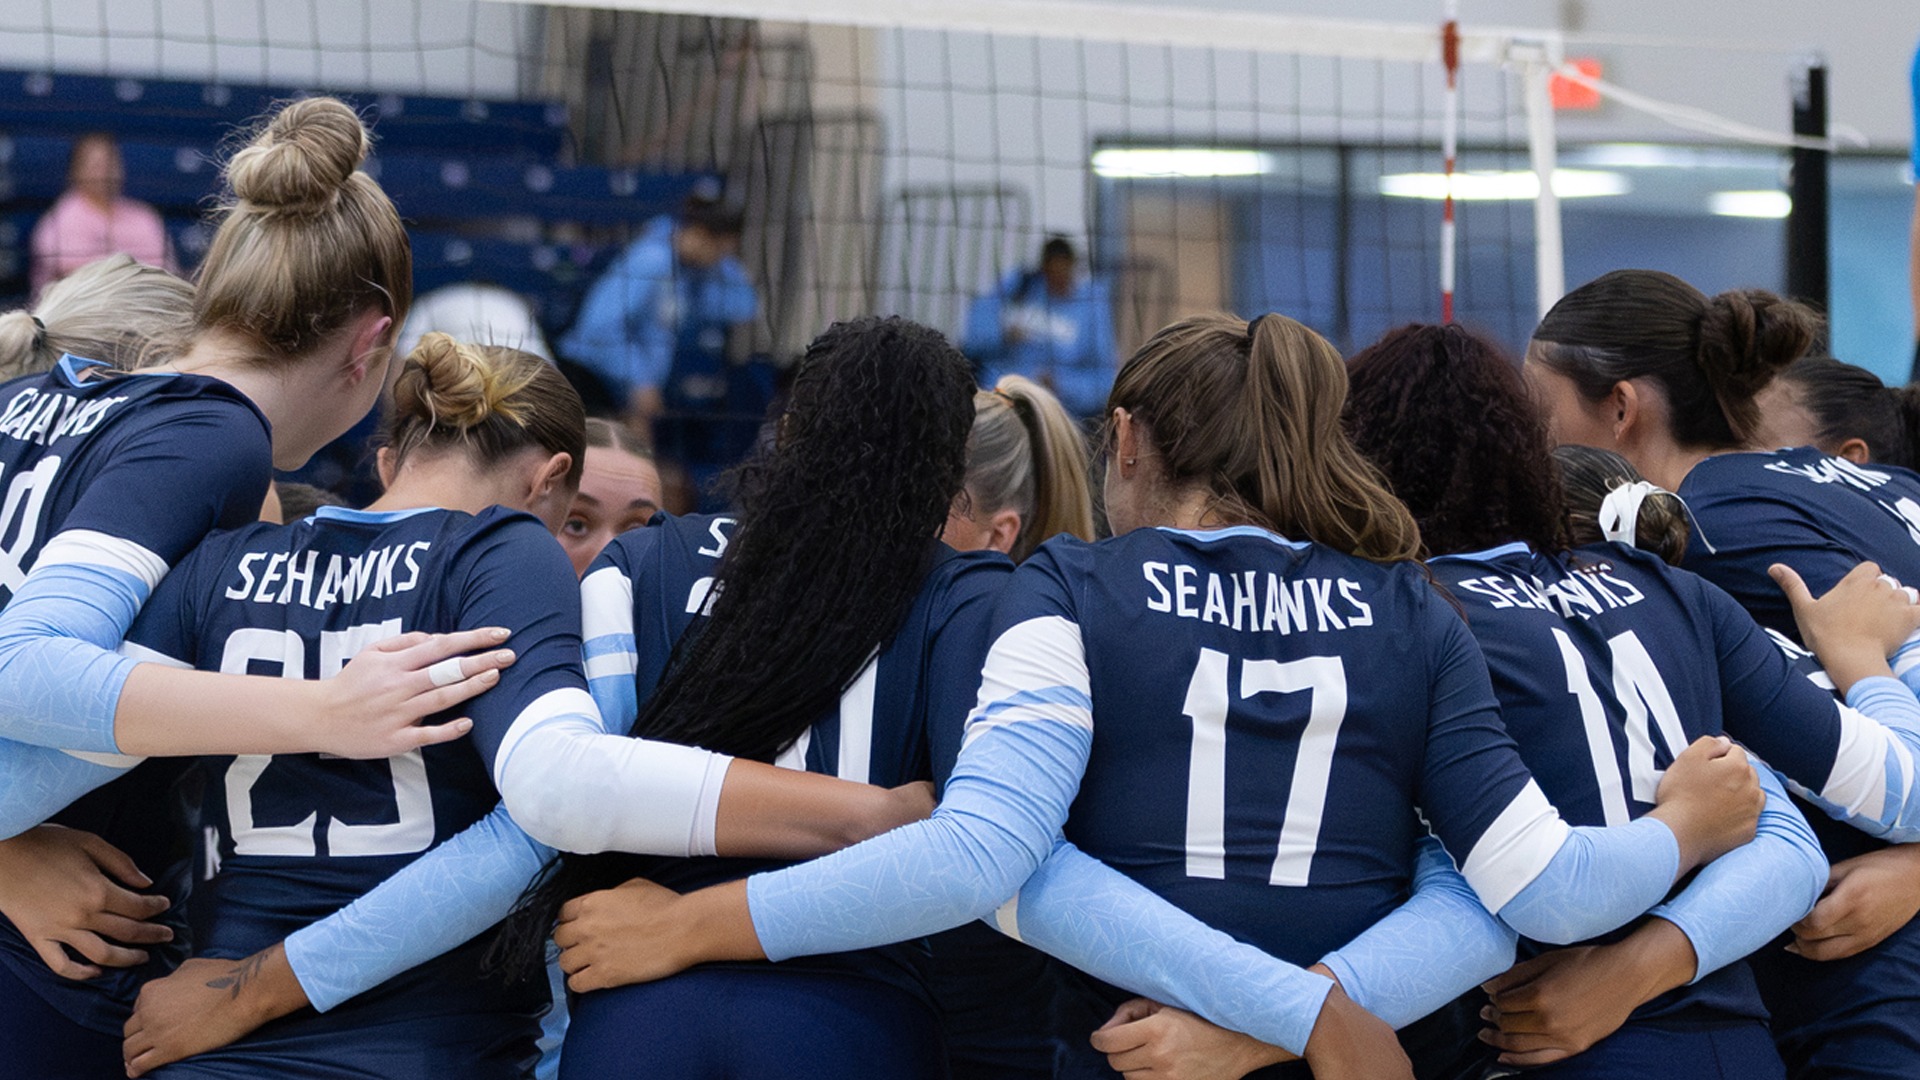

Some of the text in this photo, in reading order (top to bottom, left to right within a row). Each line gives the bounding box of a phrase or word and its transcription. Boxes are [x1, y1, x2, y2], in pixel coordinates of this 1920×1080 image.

[1143, 561, 1374, 636] SEAHAWKS
[1182, 647, 1348, 887] 17
[1550, 627, 1690, 828] 14
